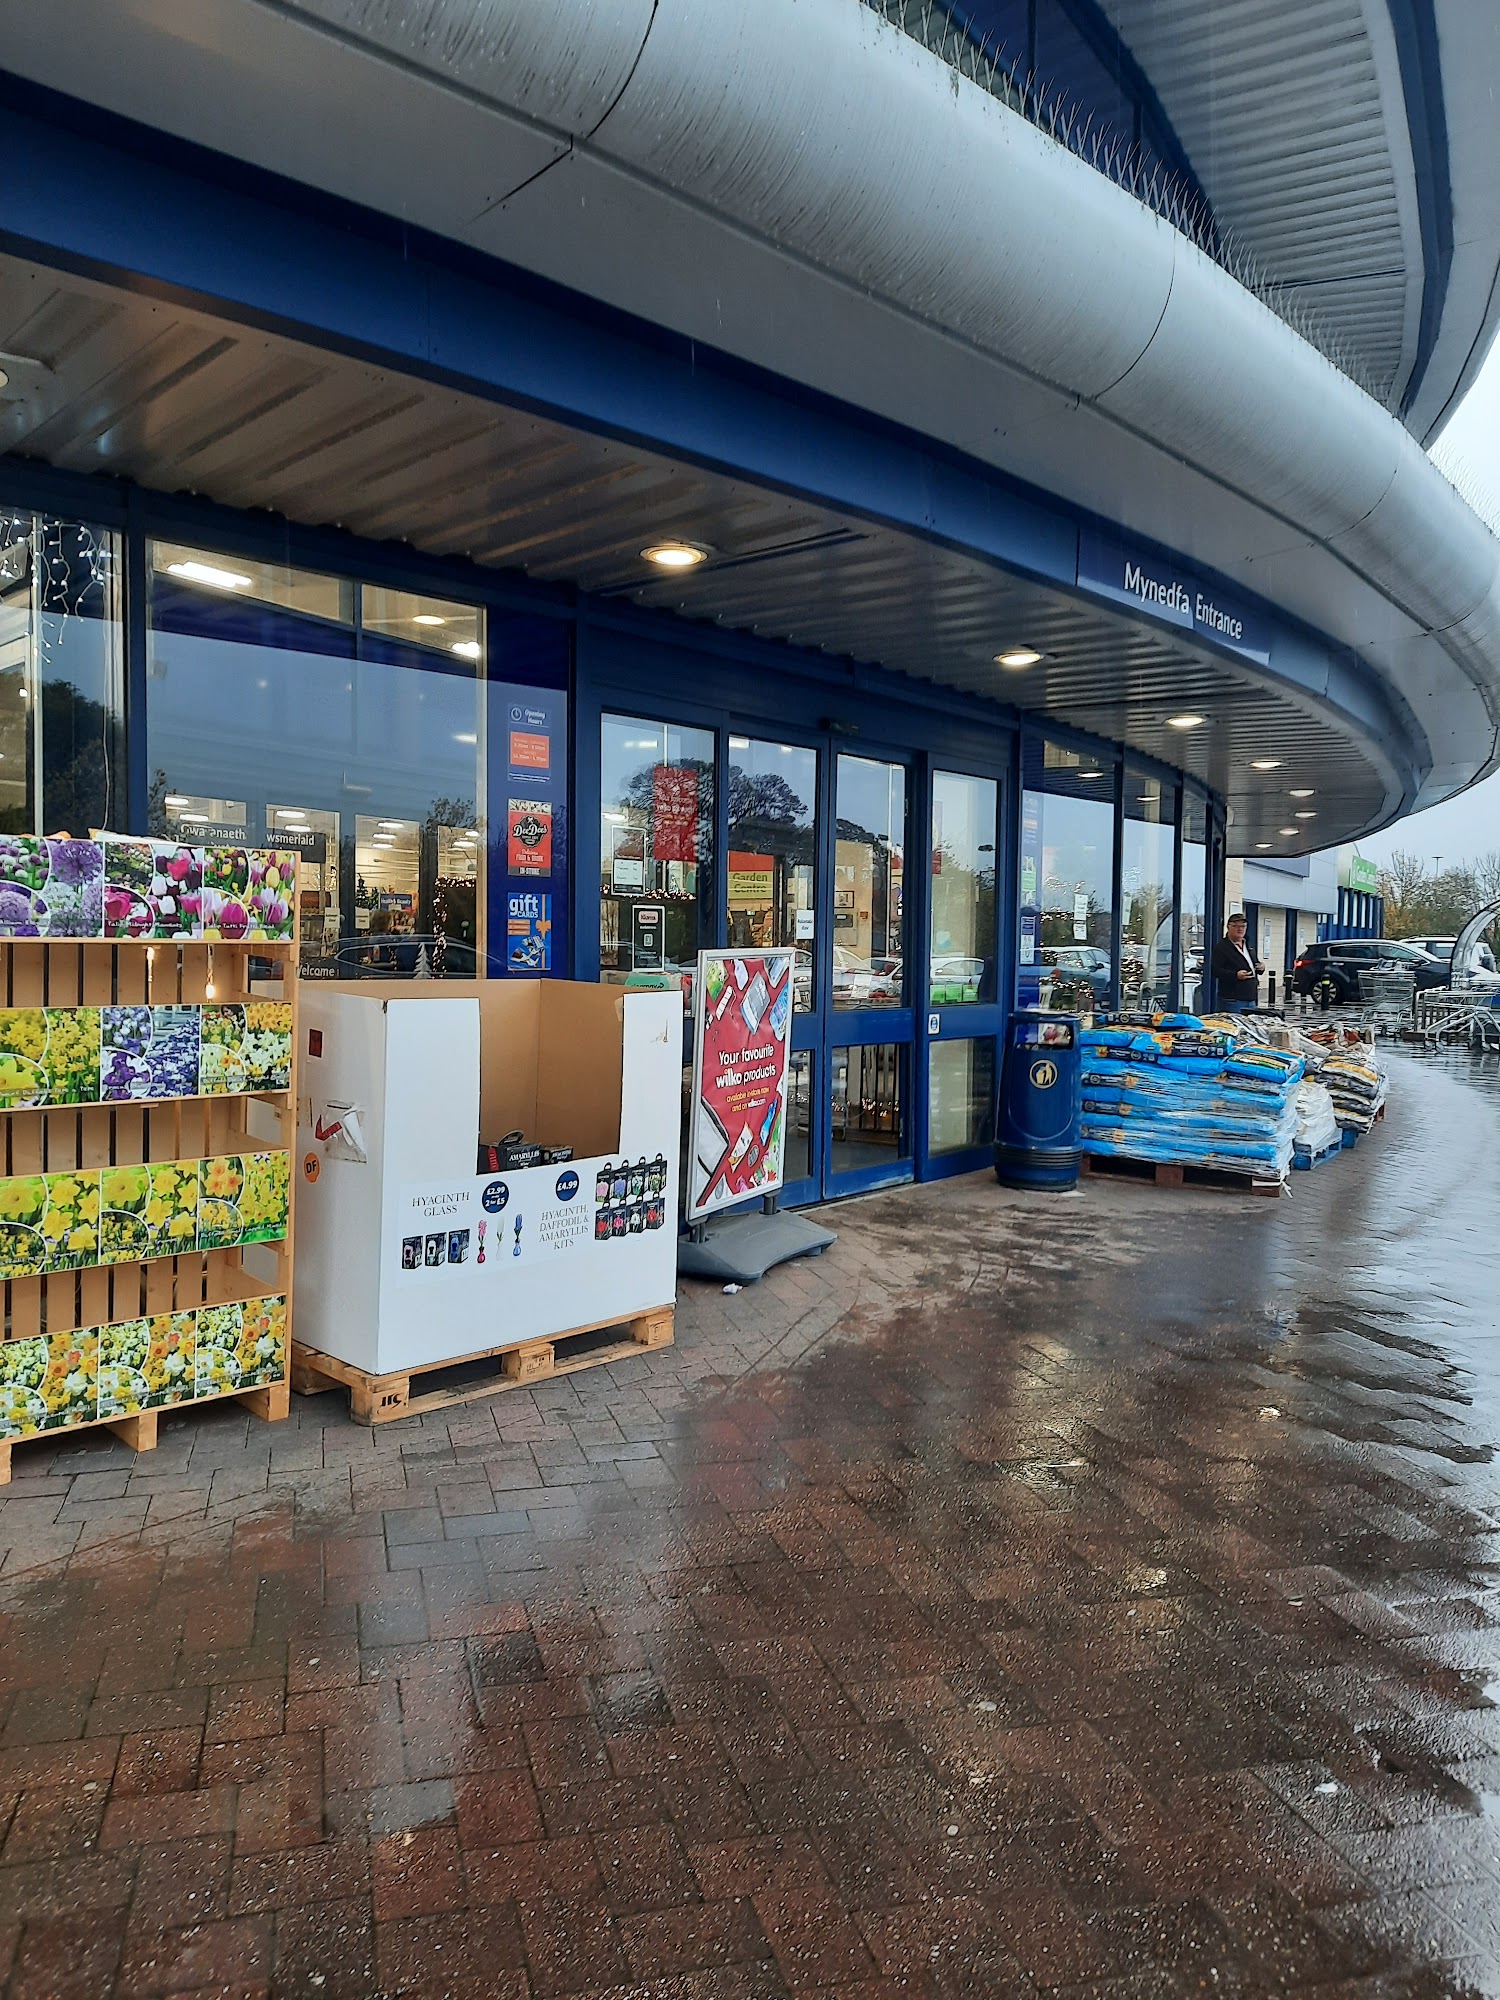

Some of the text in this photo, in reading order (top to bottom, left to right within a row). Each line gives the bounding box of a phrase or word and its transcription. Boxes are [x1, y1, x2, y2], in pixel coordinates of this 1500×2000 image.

[1124, 561, 1243, 640] Mynedfa Entrance
[733, 872, 768, 882] Garden
[733, 883, 767, 893] Centre
[509, 894, 539, 916] gift
[517, 910, 539, 919] CARDS
[719, 1043, 774, 1066] Your favourite
[716, 1063, 776, 1088] wilko products
[509, 1150, 540, 1161] AMARYLLIS
[305, 1163, 317, 1174] DF
[487, 1186, 506, 1196] £2.99
[557, 1180, 578, 1193] £4.99
[412, 1191, 470, 1207] HYACINTH
[497, 1197, 505, 1206] £5
[423, 1205, 458, 1217] GLASS
[539, 1215, 589, 1232] DAFFODIL &
[539, 1226, 589, 1243] AMARYLLIS
[553, 1239, 574, 1250] KITS
